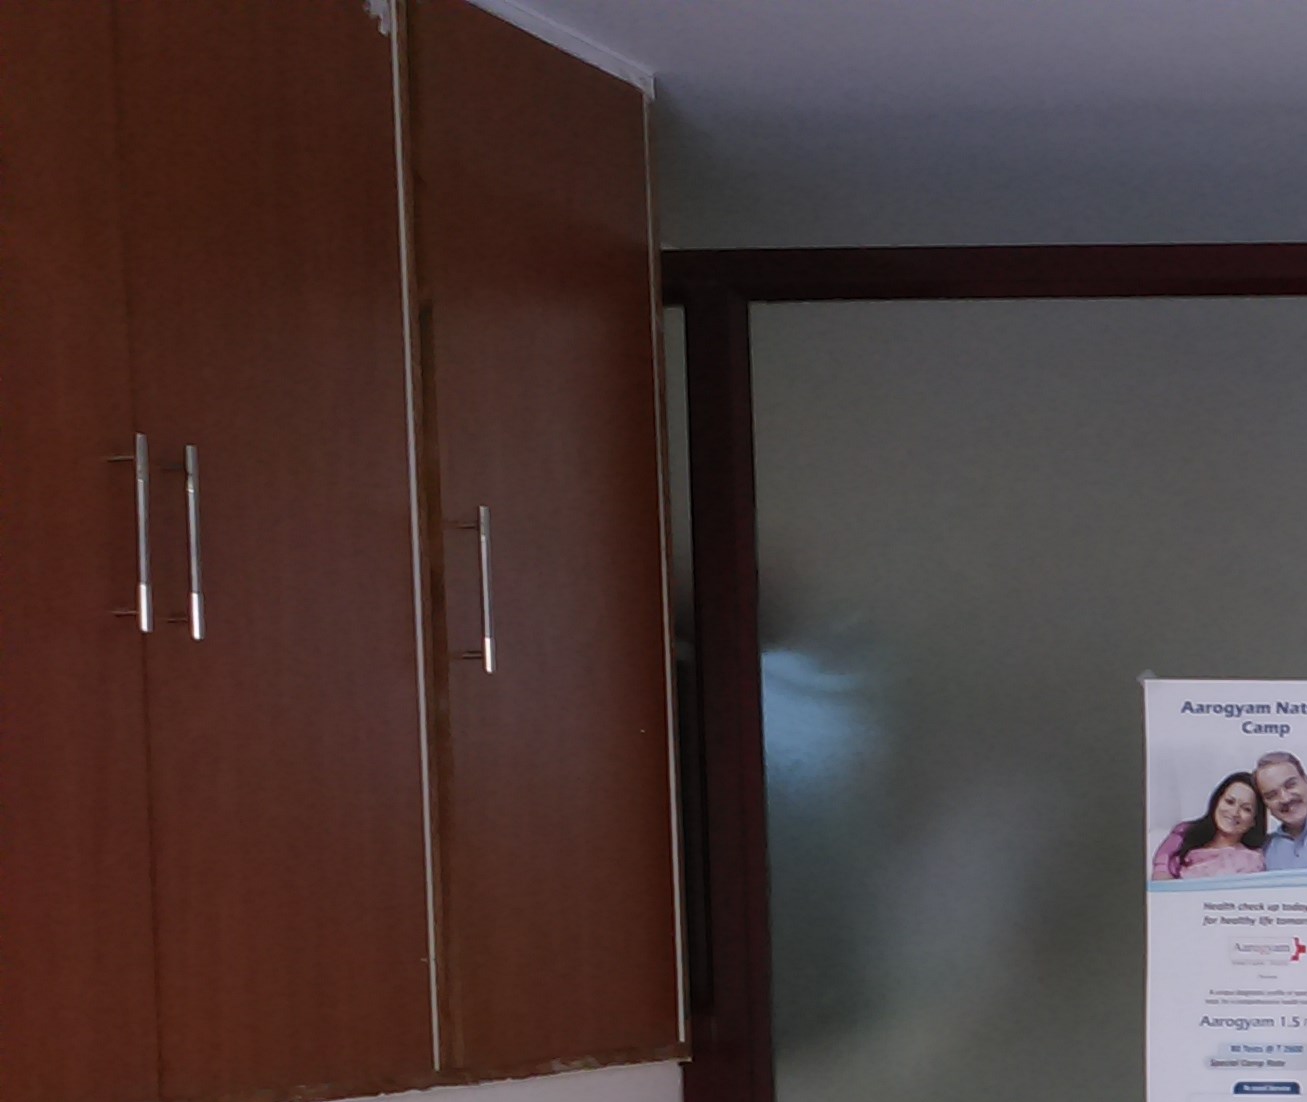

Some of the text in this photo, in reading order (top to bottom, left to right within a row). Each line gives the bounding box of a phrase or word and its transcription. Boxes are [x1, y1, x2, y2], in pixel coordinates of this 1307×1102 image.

[1181, 700, 1273, 718] Aarogyam
[1241, 721, 1291, 737] Camp
[1203, 902, 1235, 911] Health
[1238, 902, 1264, 911] check
[1267, 903, 1279, 912] up
[1202, 916, 1218, 926] for
[1220, 916, 1256, 926] healthy
[1259, 916, 1274, 926] life
[1199, 1015, 1275, 1030] Aarogyam
[1280, 1015, 1301, 1028] 1.5
